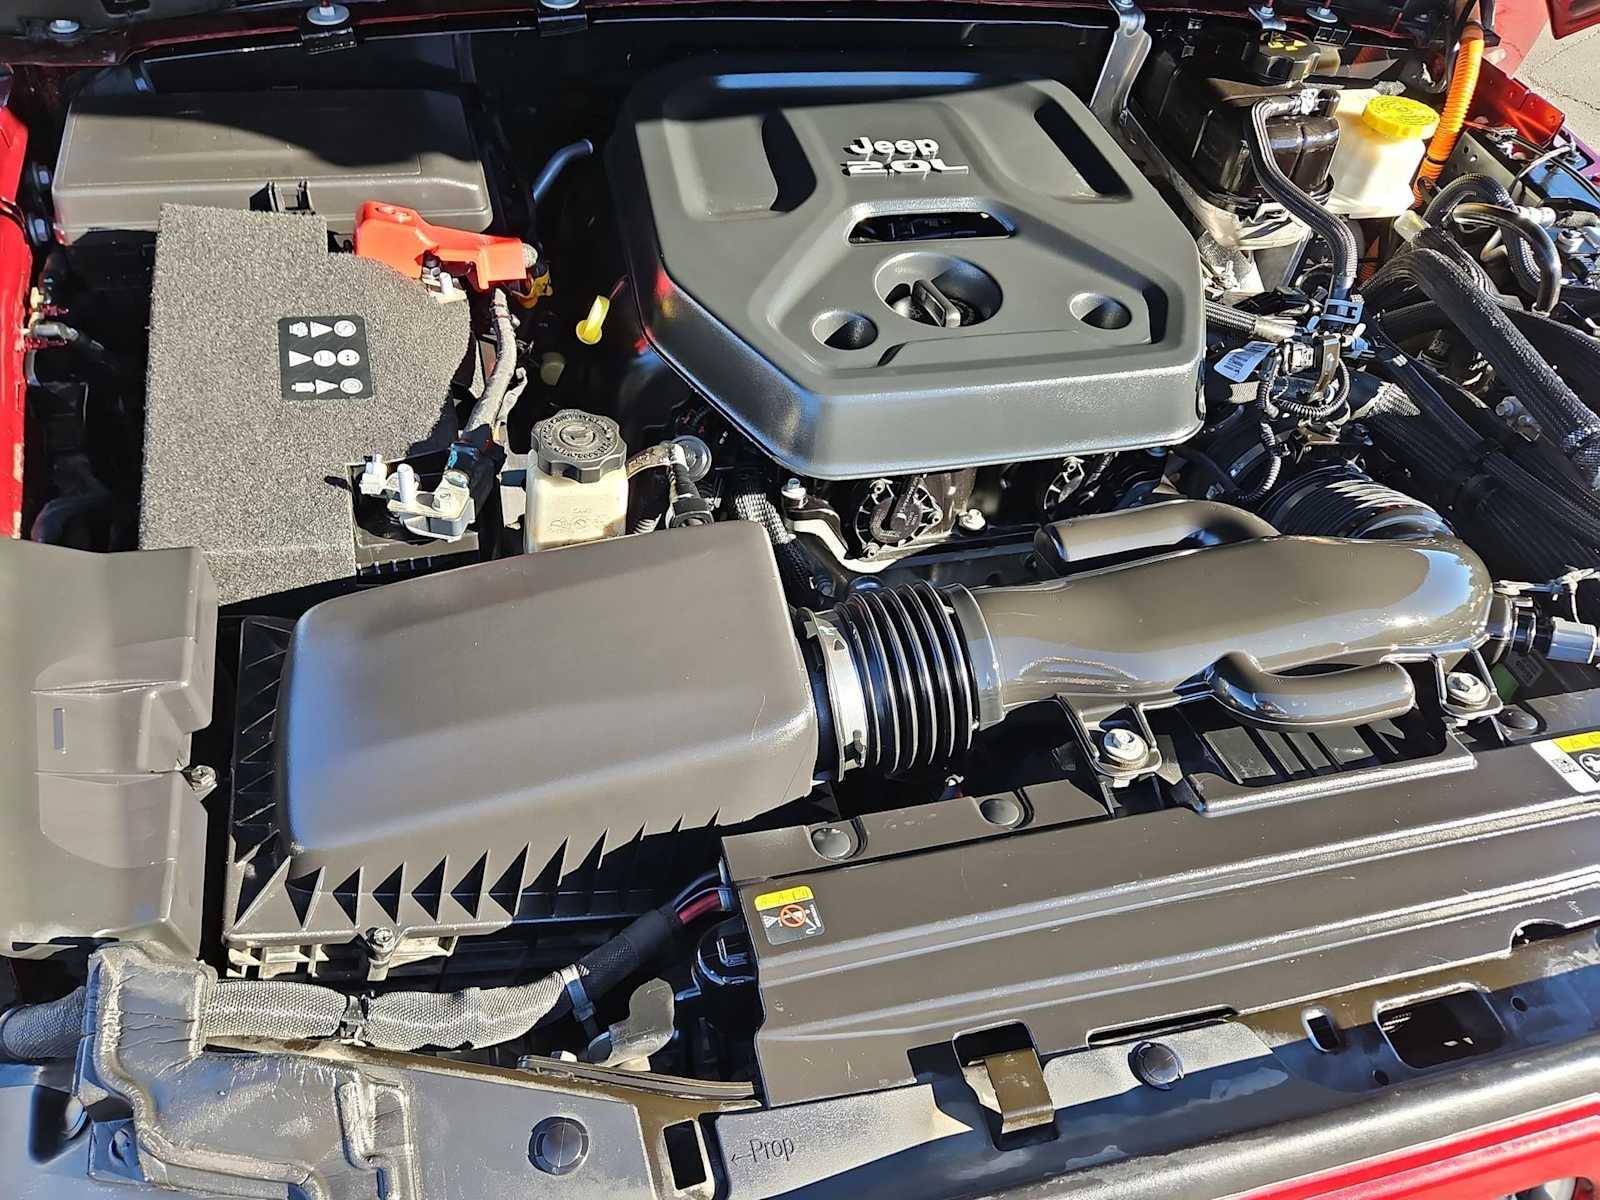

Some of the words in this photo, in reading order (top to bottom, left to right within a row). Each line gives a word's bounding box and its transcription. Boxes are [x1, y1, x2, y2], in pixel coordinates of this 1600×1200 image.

[847, 136, 939, 158] Jeep
[845, 158, 969, 176] 2.0L
[749, 1137, 795, 1163] Prop
